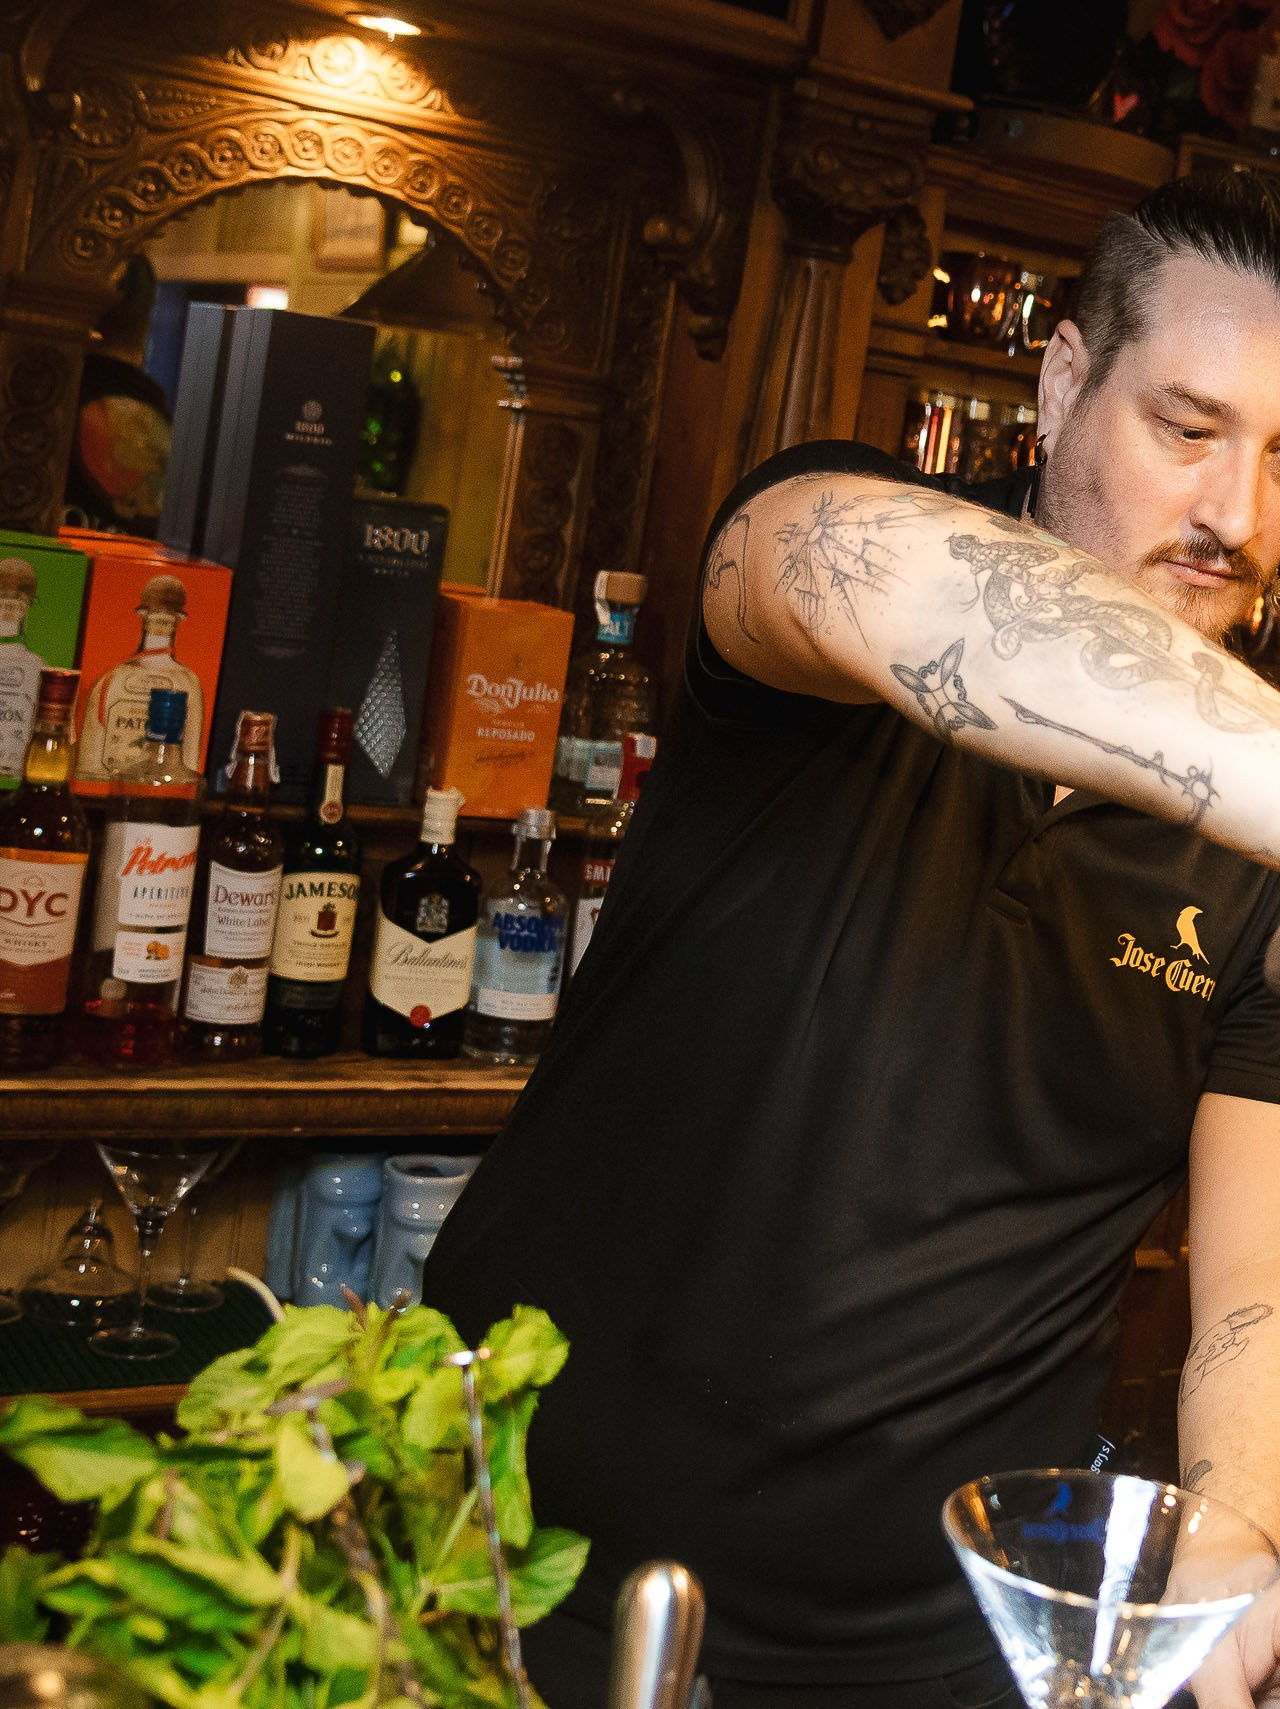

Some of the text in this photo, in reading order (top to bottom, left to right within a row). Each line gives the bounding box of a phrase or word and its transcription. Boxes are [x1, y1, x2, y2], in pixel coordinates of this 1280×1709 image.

[362, 523, 431, 556] 1800
[116, 715, 150, 732] PAT
[476, 727, 536, 743] REPOSADO
[284, 880, 359, 901] JAMESO
[0, 886, 70, 918] DYC
[217, 915, 245, 928] White
[1109, 933, 1166, 977] Jose
